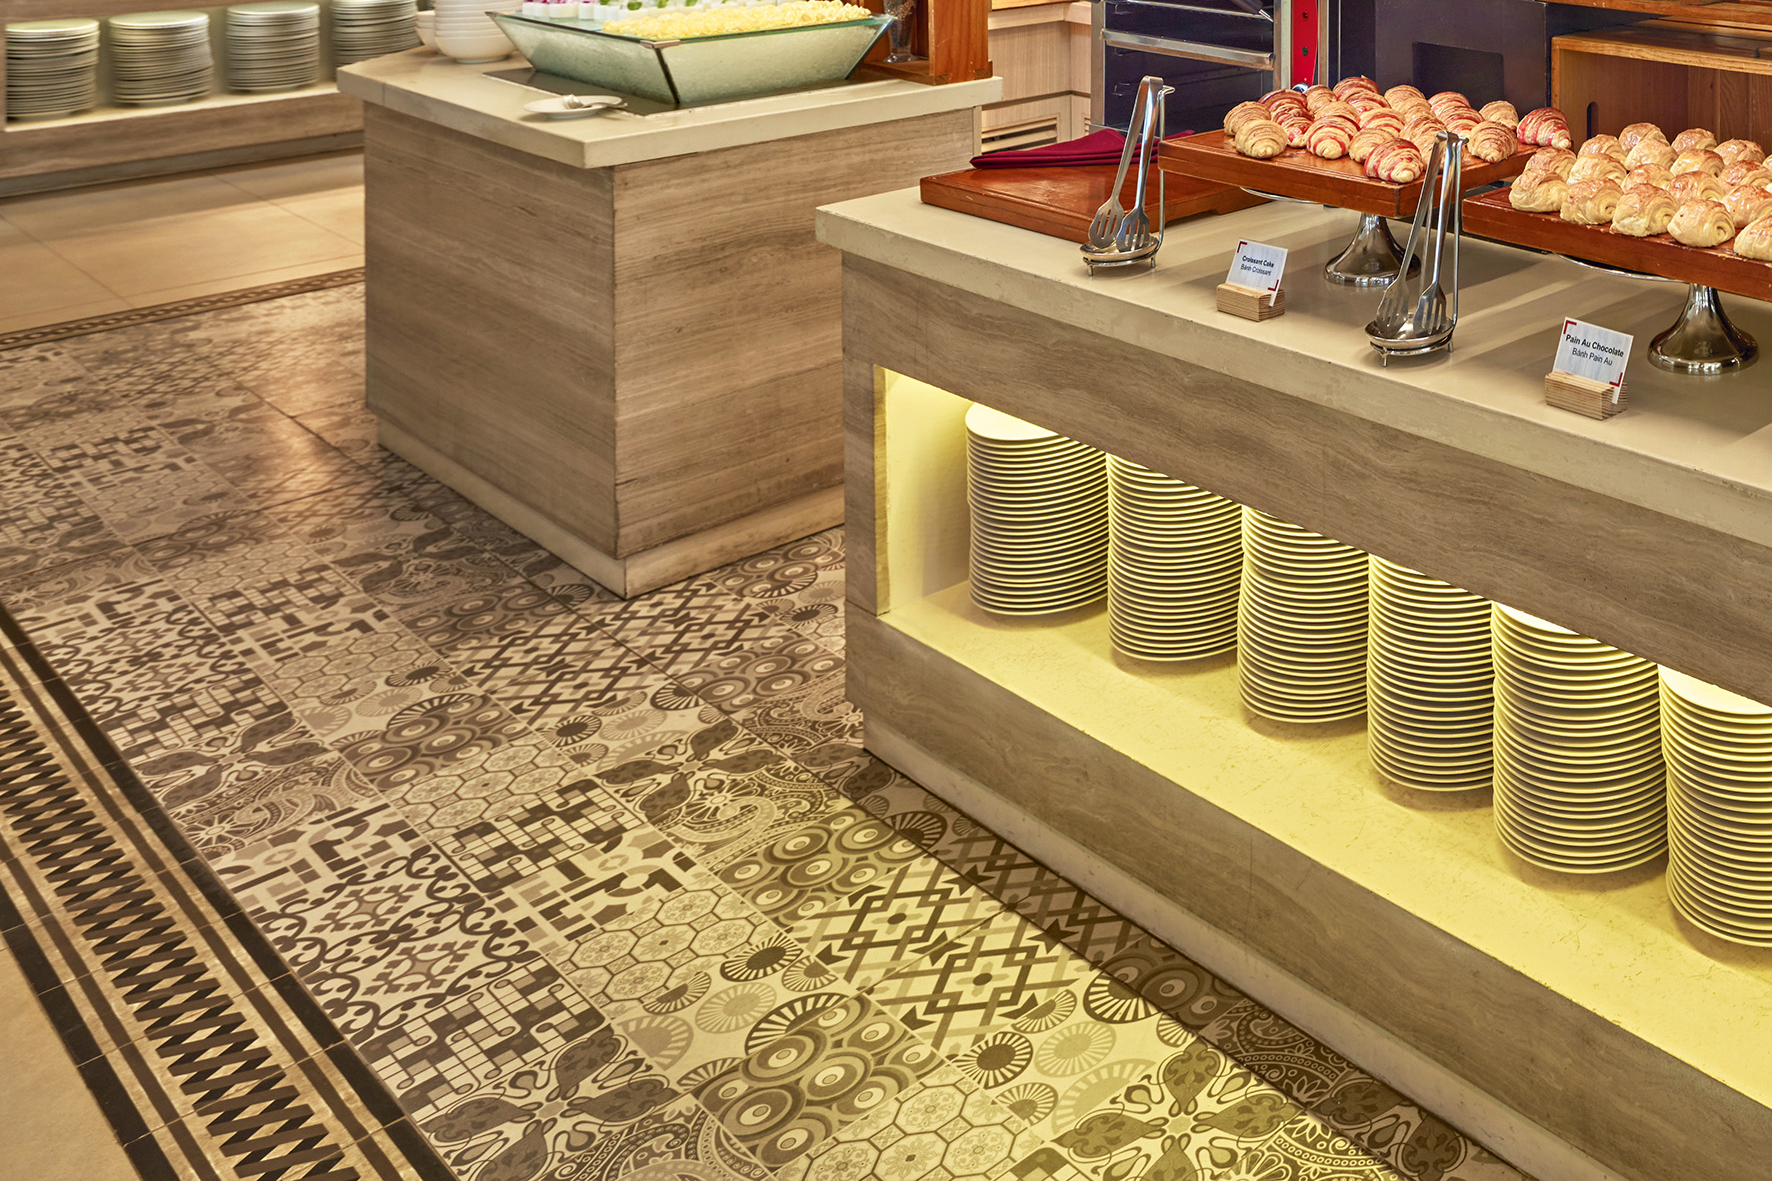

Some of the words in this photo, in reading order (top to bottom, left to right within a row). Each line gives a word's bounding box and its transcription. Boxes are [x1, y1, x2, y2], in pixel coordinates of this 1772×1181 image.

[1566, 334, 1580, 345] Pain
[1582, 338, 1590, 348] Au
[1592, 342, 1624, 357] Chocolate
[1572, 347, 1588, 358] Bánh
[1589, 352, 1603, 363] Pain
[1604, 357, 1613, 366] Au
